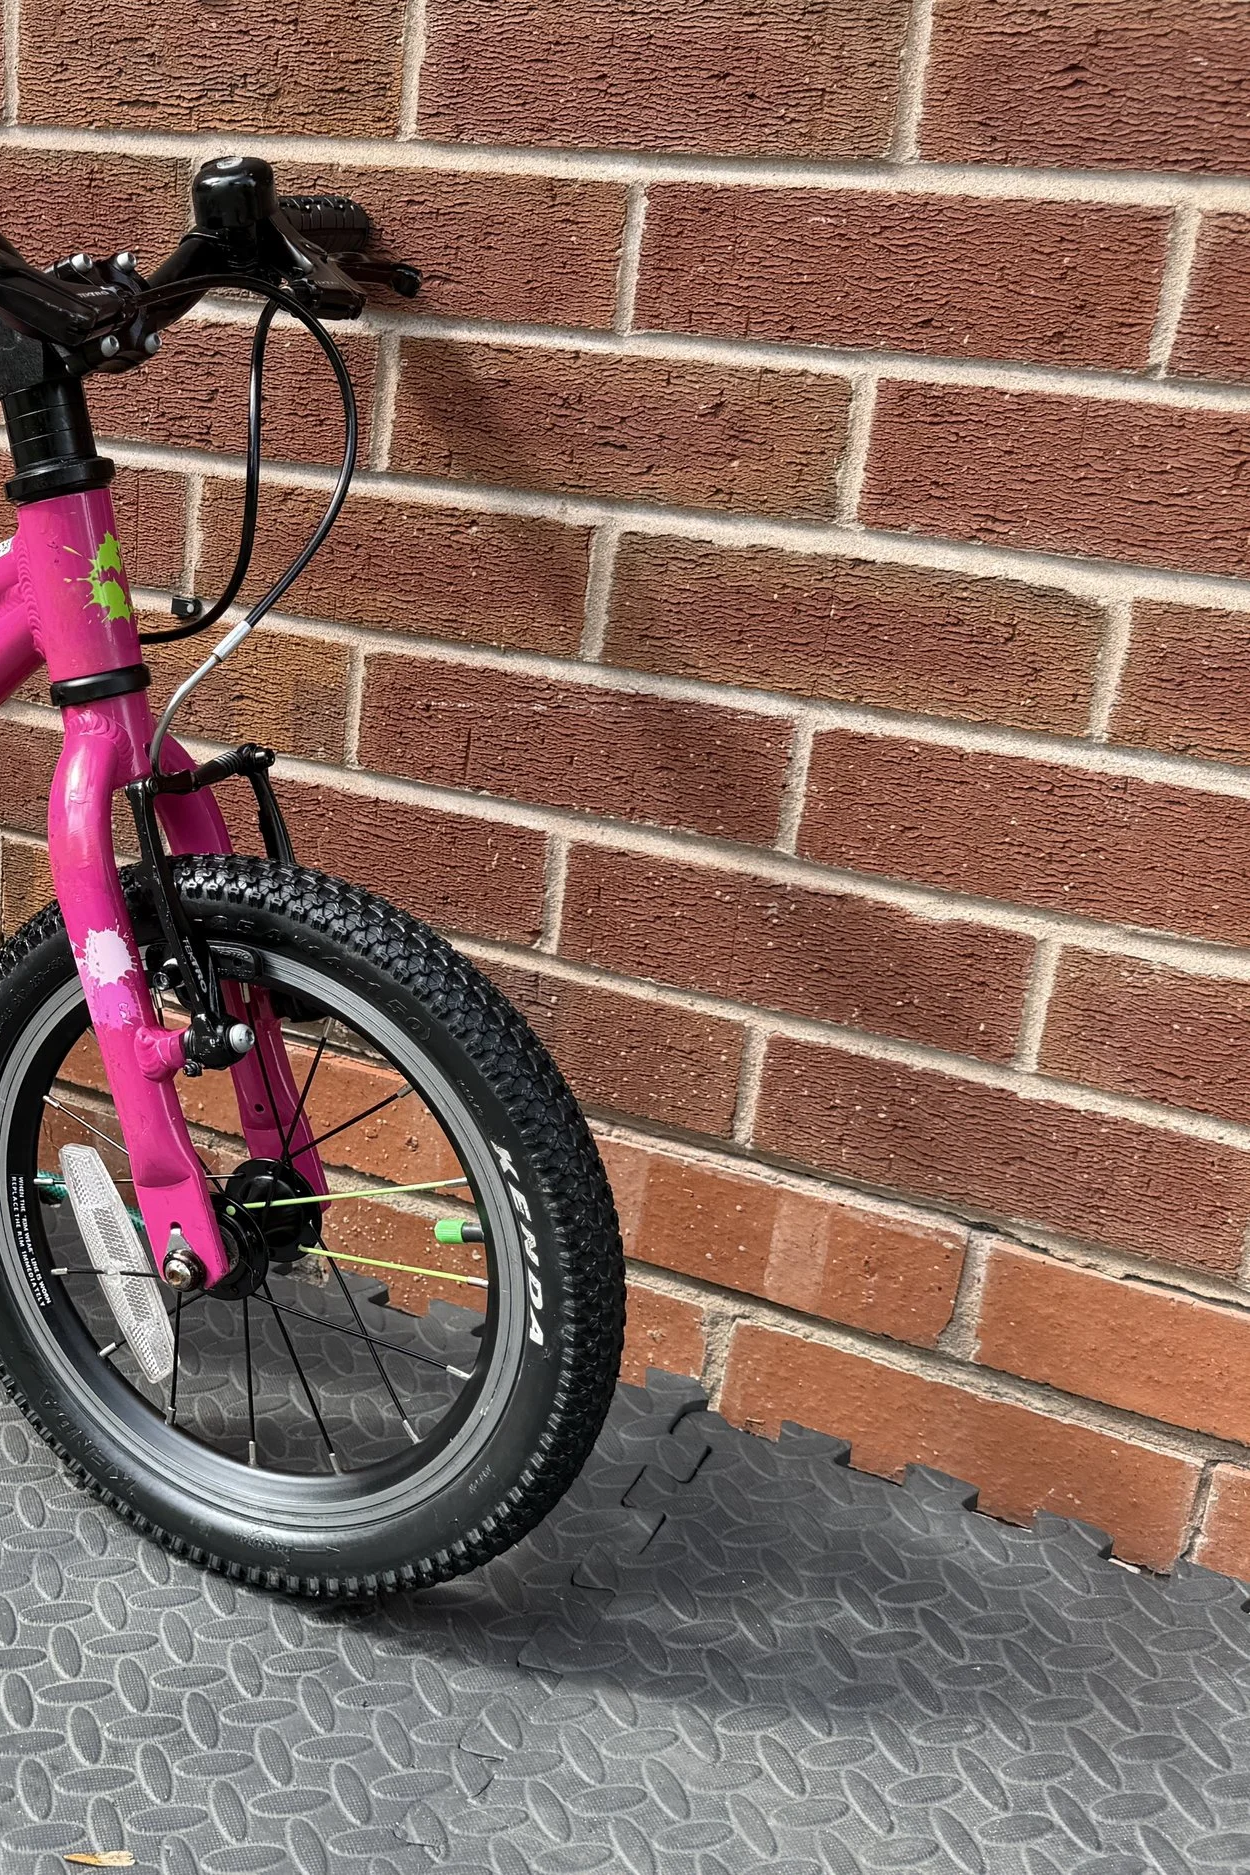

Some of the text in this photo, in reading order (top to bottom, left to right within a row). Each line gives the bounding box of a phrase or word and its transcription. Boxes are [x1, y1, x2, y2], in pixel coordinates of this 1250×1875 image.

[182, 936, 207, 993] TEKTRO
[11, 1176, 46, 1307] REPLACE THE RIM IMMEDIATELY
[490, 1139, 544, 1347] KENDA
[30, 1257, 40, 1274] LINE
[35, 1273, 43, 1281] IS
[38, 1280, 52, 1304] WORN
